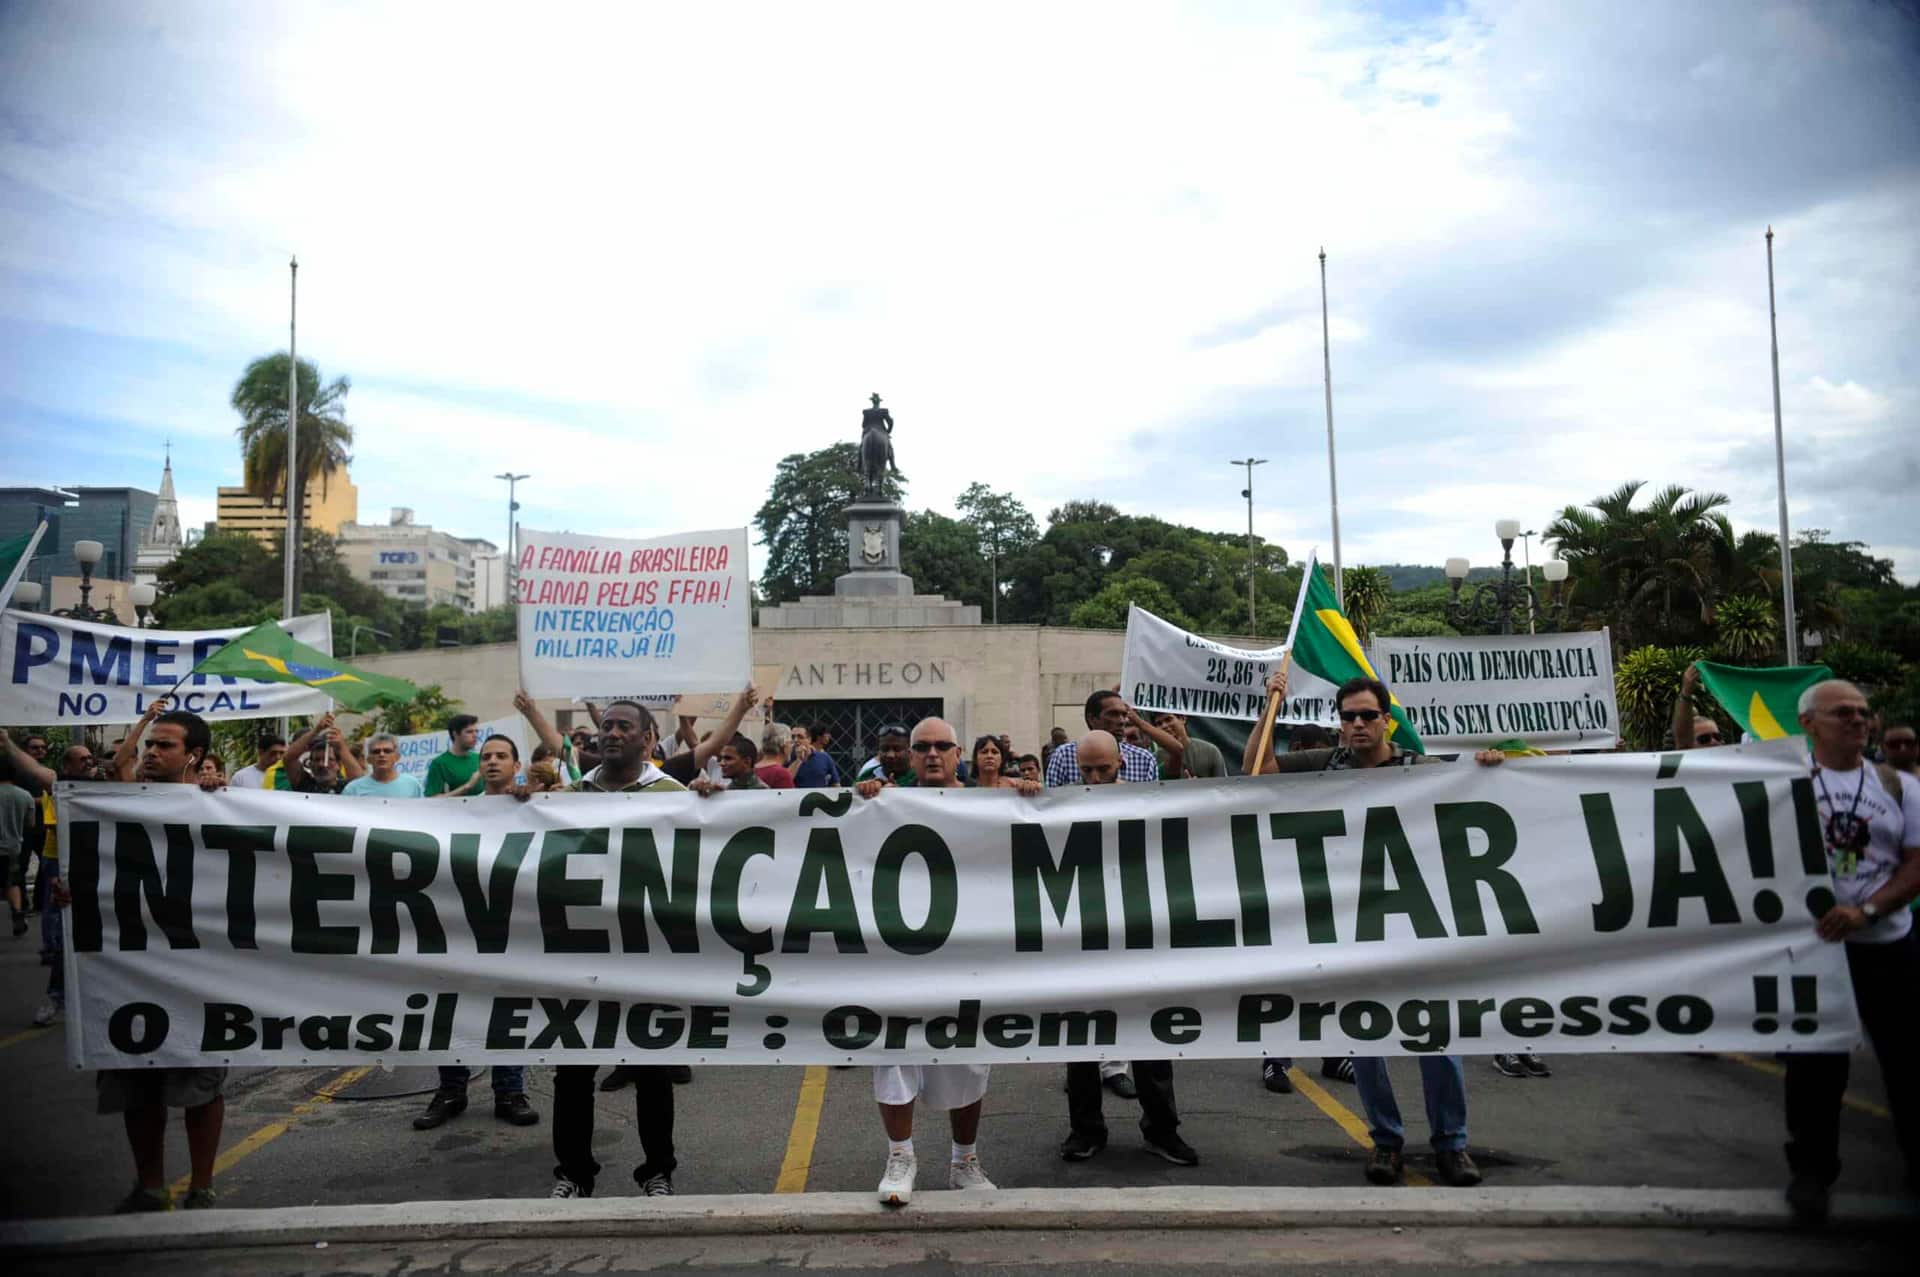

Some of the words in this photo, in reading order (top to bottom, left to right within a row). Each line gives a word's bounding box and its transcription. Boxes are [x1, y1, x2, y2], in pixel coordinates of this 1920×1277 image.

[519, 544, 535, 571] A
[539, 546, 622, 574] FAMÍLIA
[629, 545, 729, 574] BRASILEIRA
[516, 579, 590, 604] CLAMA
[596, 580, 659, 607] PELAS
[668, 575, 732, 608] FFAA!
[534, 607, 675, 635] INTERVENÇÃO
[12, 622, 294, 686] PMER
[535, 639, 619, 658] MILITAR
[1389, 645, 1432, 683] PAÍS
[1436, 649, 1475, 681] COM
[1480, 647, 1598, 680] DEMOCRACIA
[1206, 657, 1253, 688] 28,86
[58, 692, 107, 716] NO
[136, 690, 260, 715] LOCAL
[1134, 682, 1241, 715] GARANTIDOS
[1246, 694, 1288, 722] PEO
[1294, 698, 1322, 724] STF
[1328, 699, 1336, 724] ?
[1453, 703, 1493, 736] SEM
[1496, 692, 1608, 741] CORRUPÇÃO
[68, 793, 958, 996] INTERVENÇÃO
[1011, 802, 1540, 952] MILITAR
[108, 1002, 170, 1055] O
[201, 993, 458, 1052] Brasil
[486, 997, 730, 1049] EXIGE
[822, 1000, 1117, 1050] Ordem
[1150, 1006, 1202, 1045] e
[1236, 994, 1714, 1053] Progresso
